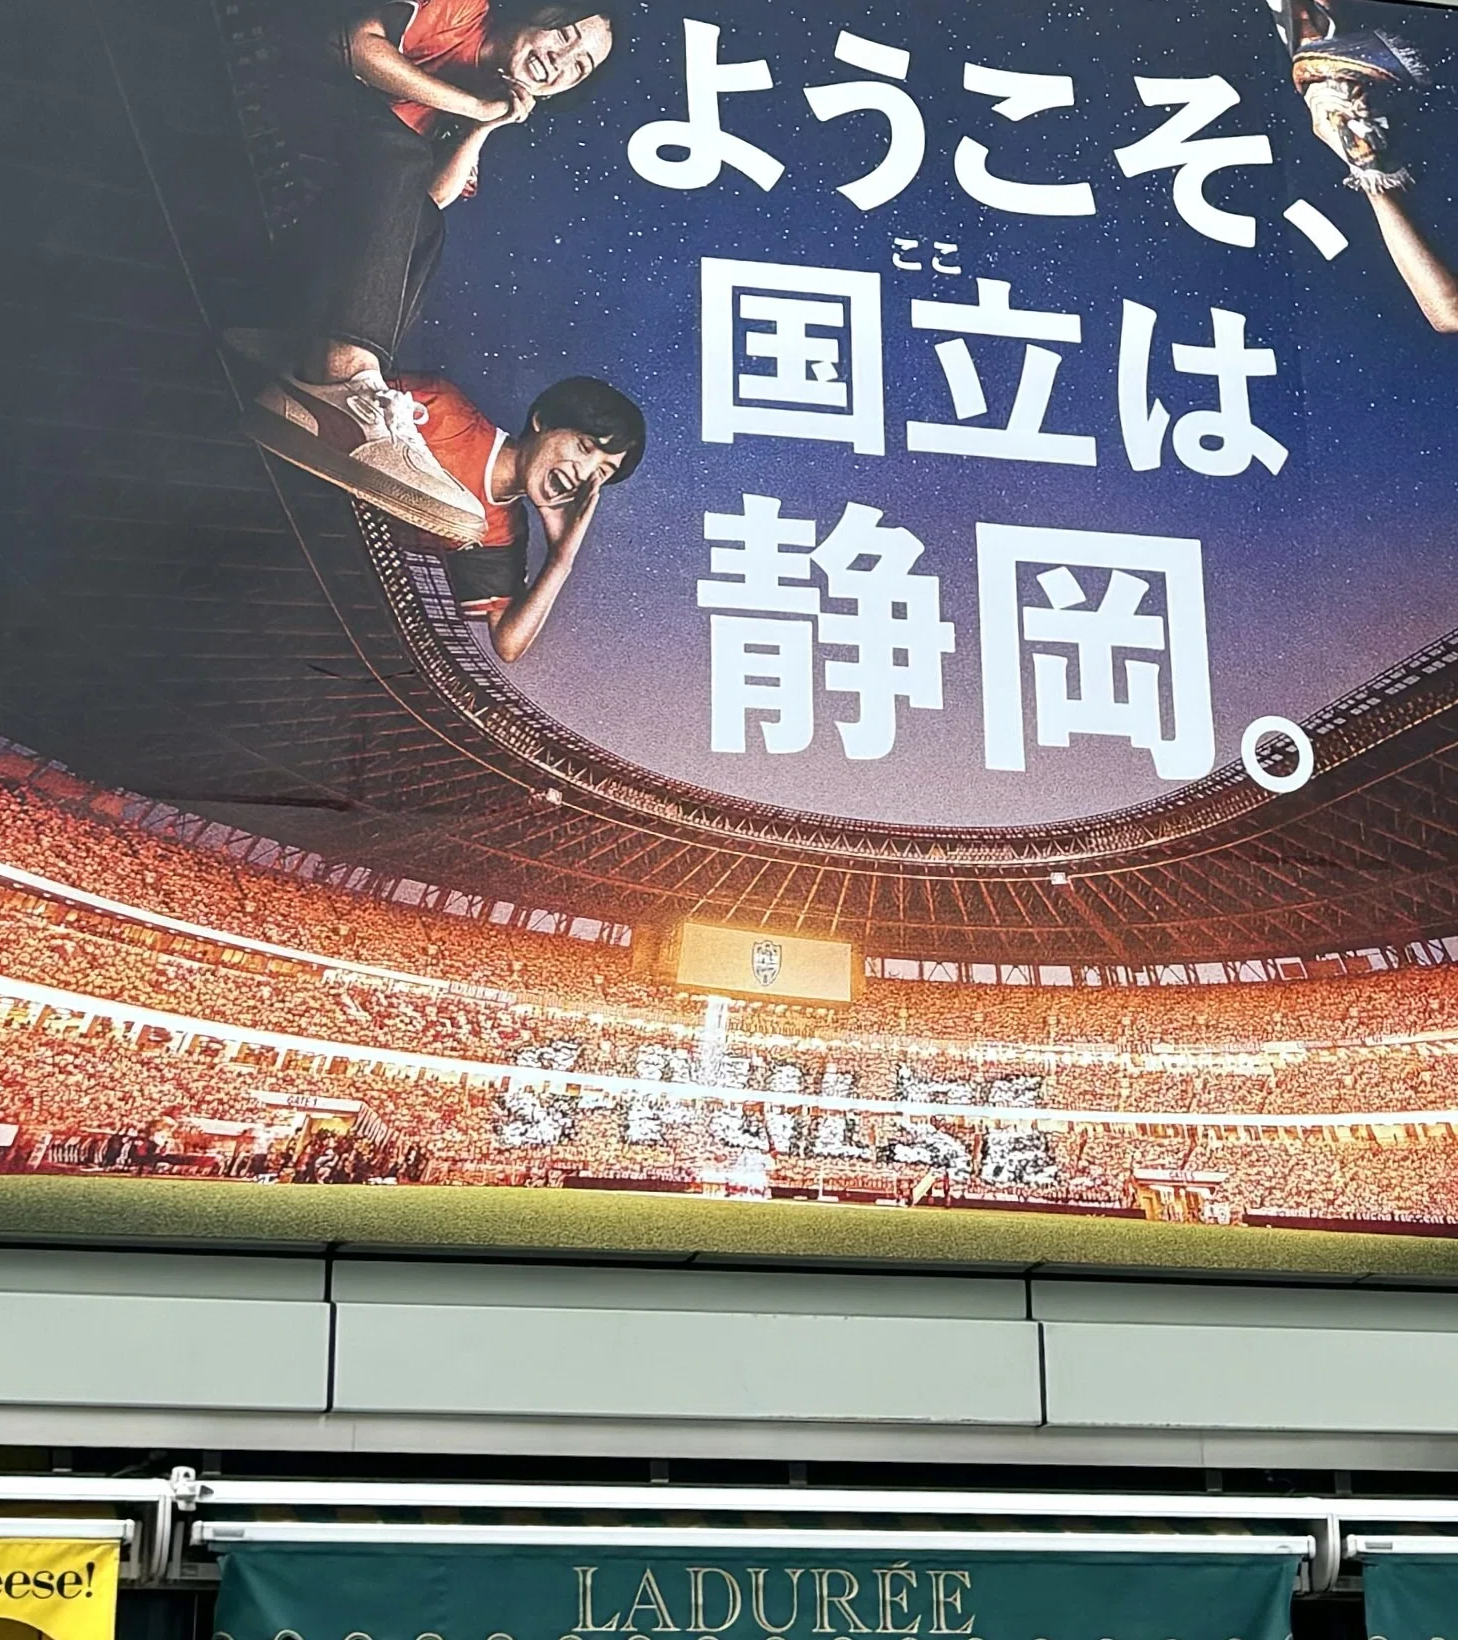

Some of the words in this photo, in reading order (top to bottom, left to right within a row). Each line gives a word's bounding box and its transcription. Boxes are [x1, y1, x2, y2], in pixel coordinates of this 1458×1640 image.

[627, 17, 1349, 261] ようこそ、
[699, 256, 1290, 478] 国立は
[892, 237, 962, 275] ここ
[697, 493, 1314, 793] 静岡。
[570, 1559, 976, 1634] LADURÉE
